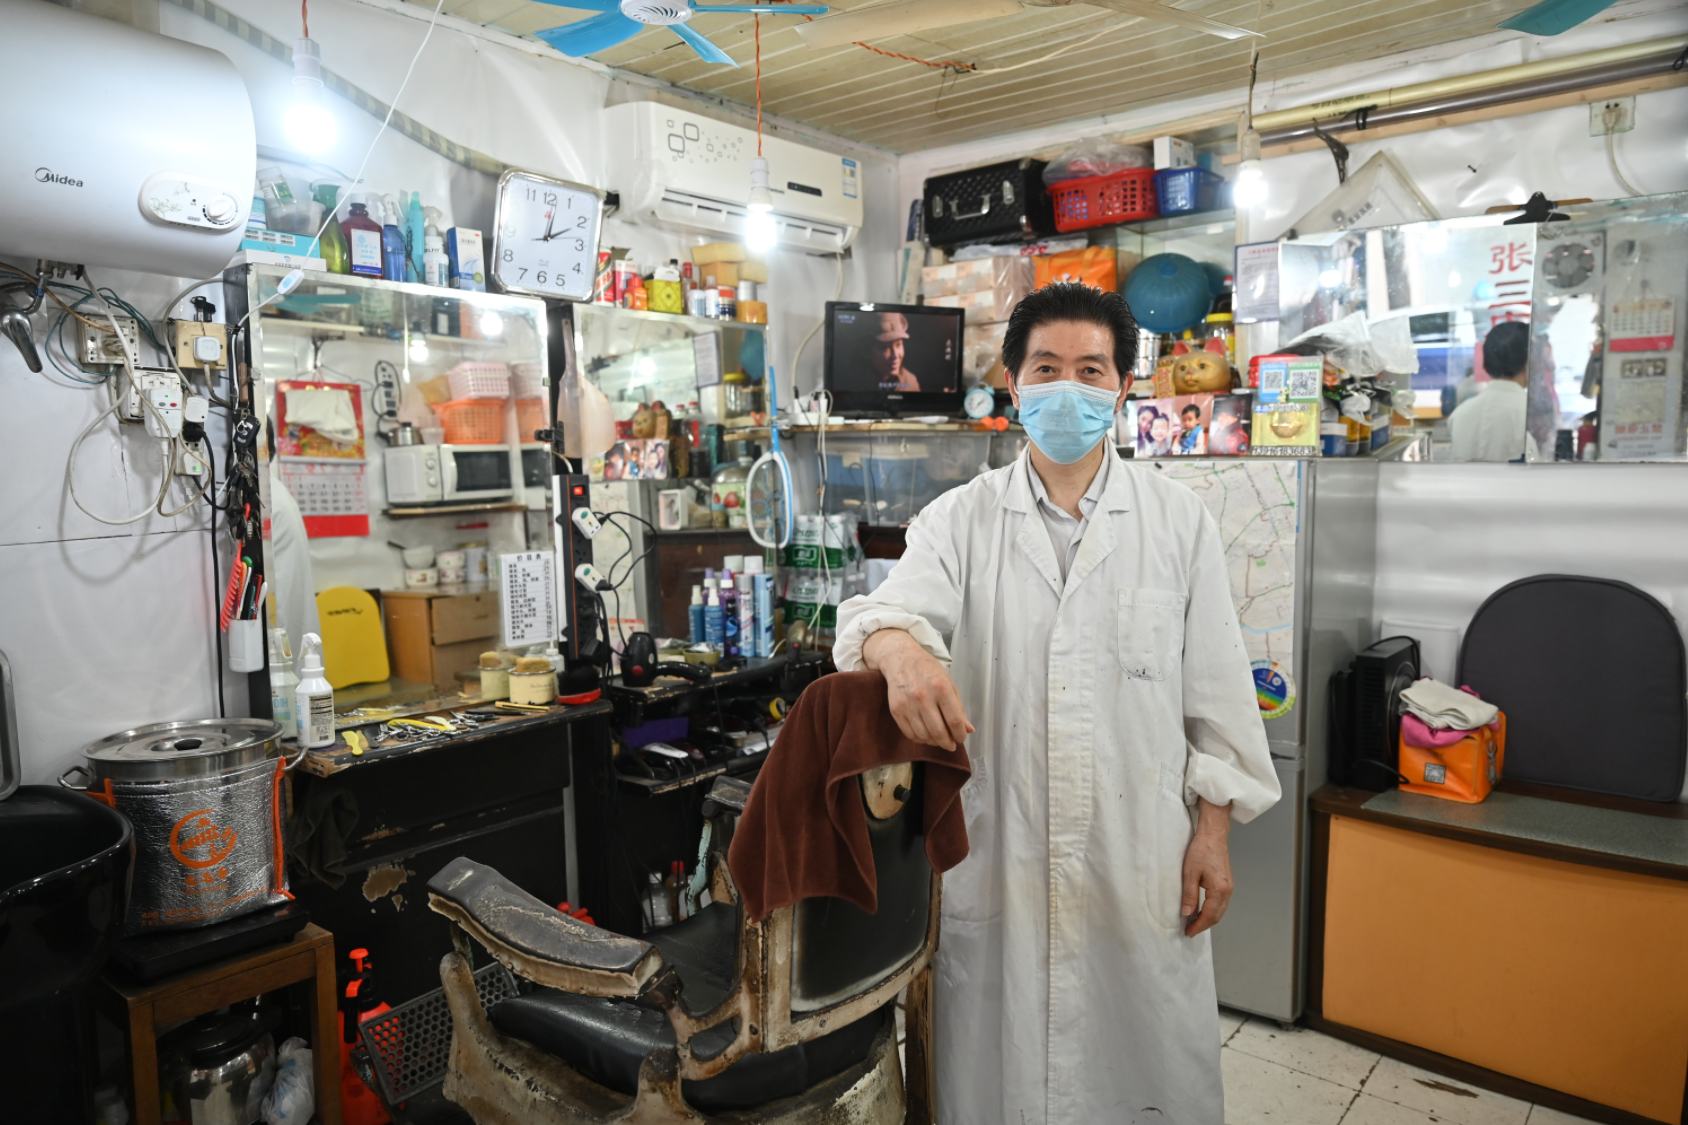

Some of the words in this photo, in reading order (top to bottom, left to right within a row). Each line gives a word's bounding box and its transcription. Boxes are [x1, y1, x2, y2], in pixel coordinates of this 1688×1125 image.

[37, 169, 83, 187] Midea
[527, 187, 536, 202] 11
[543, 192, 557, 206] 12
[567, 197, 572, 209] 1
[576, 215, 587, 229] 2
[574, 238, 584, 252] 3
[502, 248, 514, 262] 8
[518, 267, 528, 280] 7
[572, 262, 581, 274] 4
[536, 270, 547, 284] 6
[555, 273, 566, 287] 5
[517, 553, 541, 562] 价目表
